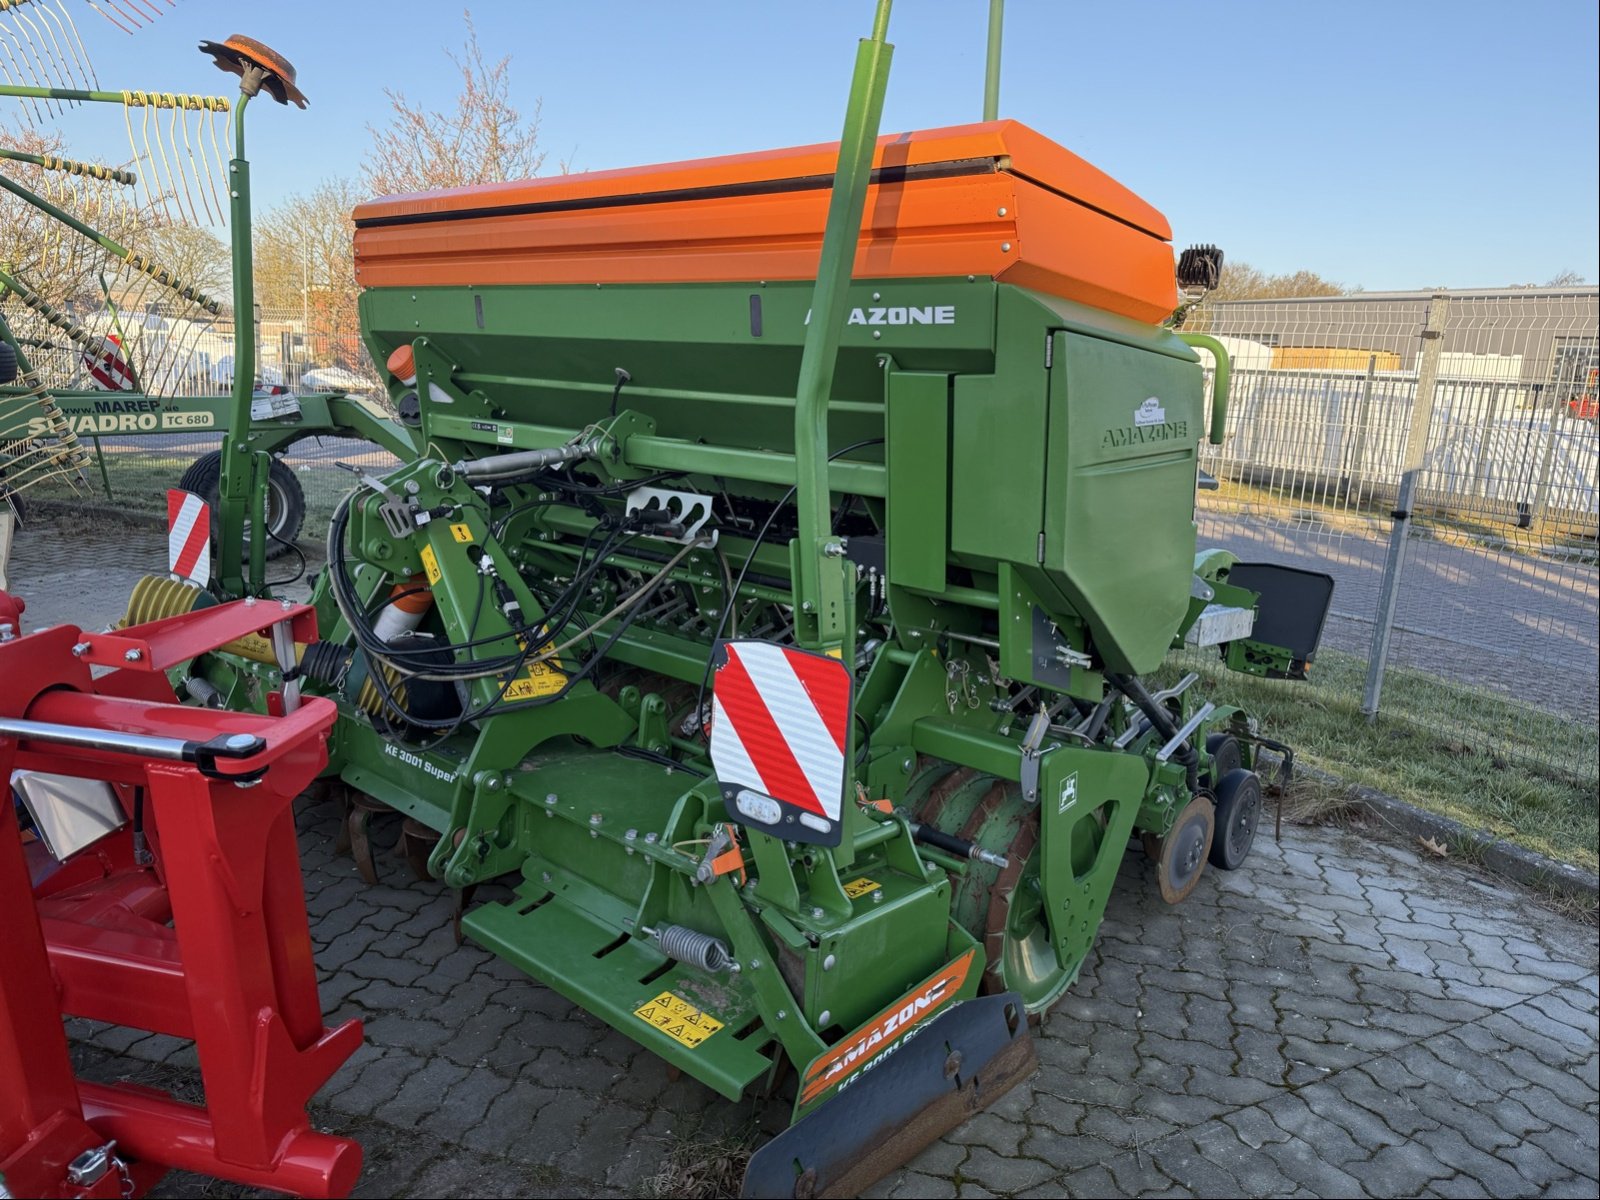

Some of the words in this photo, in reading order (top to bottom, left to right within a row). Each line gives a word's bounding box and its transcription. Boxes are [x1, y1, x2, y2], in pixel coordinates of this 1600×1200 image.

[167, 414, 183, 426] TC
[186, 414, 209, 425] 680
[1101, 420, 1187, 448] AMAZONE
[385, 743, 399, 758] KE
[399, 750, 423, 769] 3001
[423, 761, 457, 784] Super
